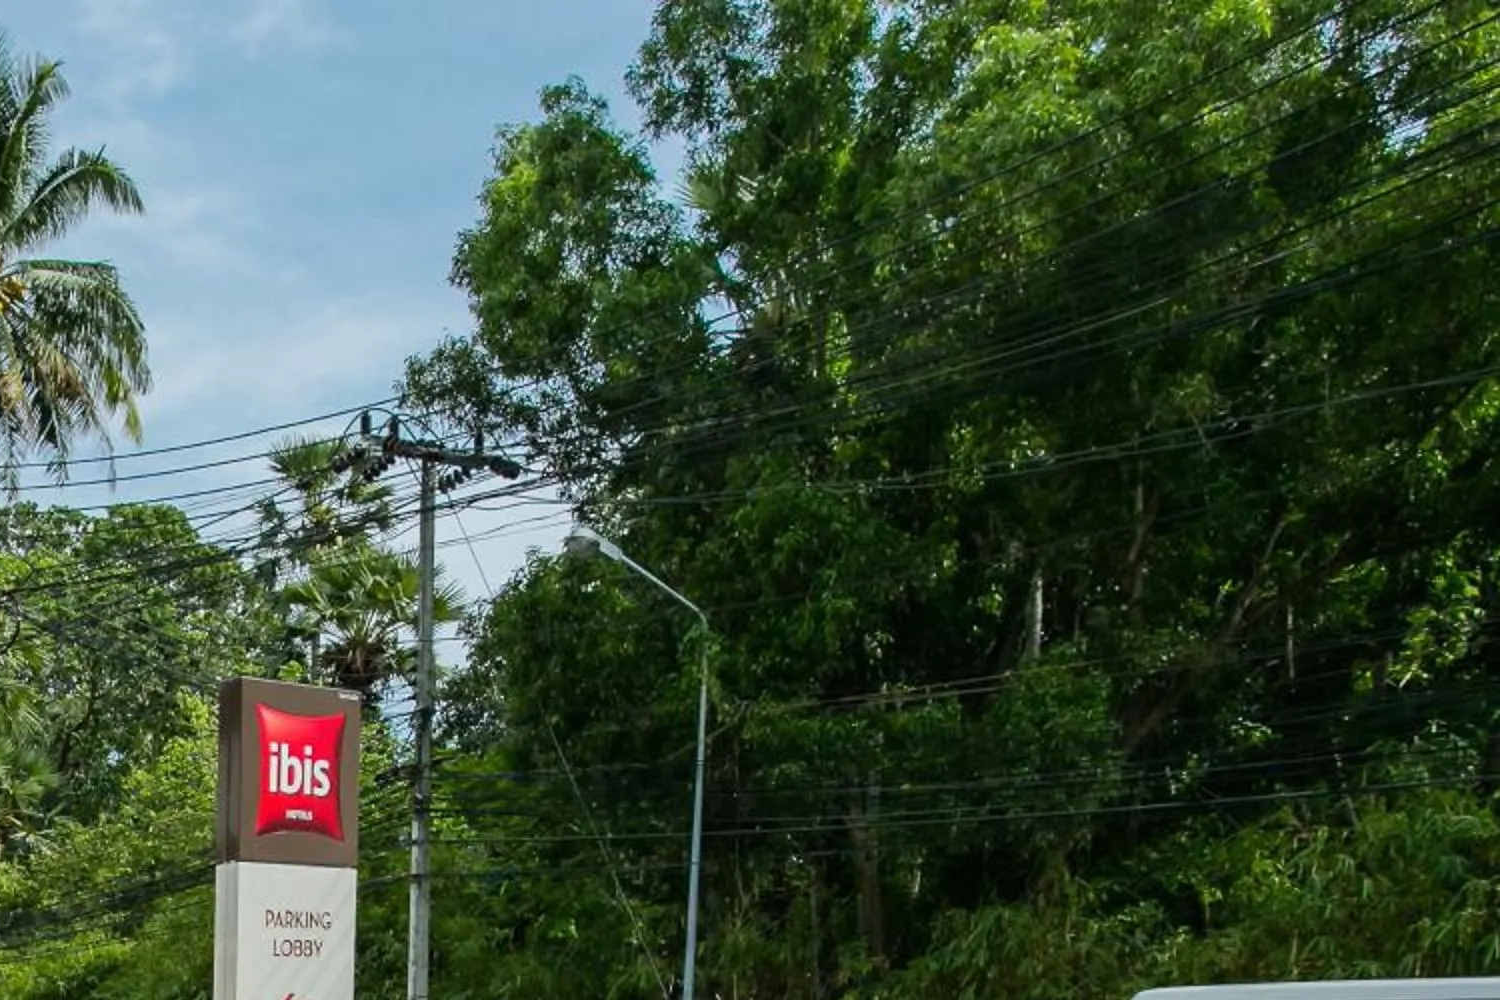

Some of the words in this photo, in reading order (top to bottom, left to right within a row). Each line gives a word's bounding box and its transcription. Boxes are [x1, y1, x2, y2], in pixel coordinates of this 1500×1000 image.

[269, 741, 331, 797] ibis
[265, 909, 332, 930] PARKING
[273, 939, 323, 957] LOBBY
